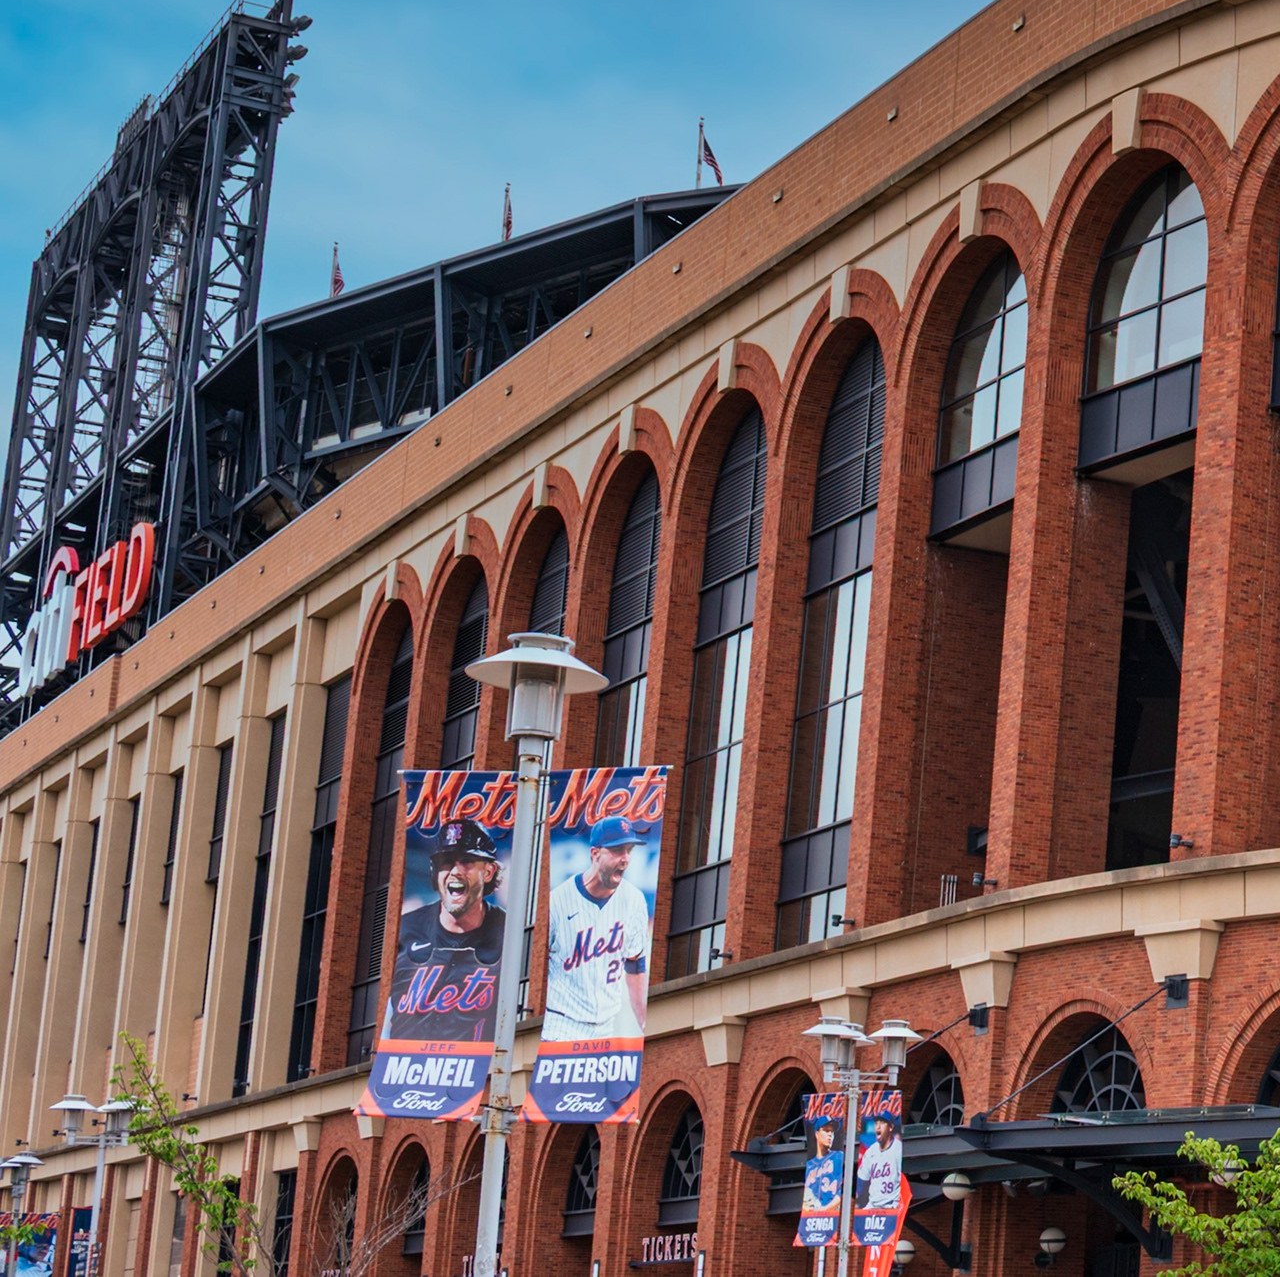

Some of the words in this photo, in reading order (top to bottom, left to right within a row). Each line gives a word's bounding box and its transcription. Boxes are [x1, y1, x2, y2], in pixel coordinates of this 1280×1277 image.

[66, 522, 154, 662] FIELD
[406, 771, 518, 829] Mets
[549, 766, 667, 829] Mets
[397, 964, 497, 1015] Mets
[420, 1042, 456, 1053] JEFF
[572, 1041, 612, 1052] DAVID
[382, 1057, 474, 1087] McNEIL
[535, 1055, 639, 1085] PETERSON
[392, 1090, 447, 1112] Ford
[555, 1091, 608, 1114] Ford
[805, 1093, 846, 1121] Mets
[860, 1090, 902, 1118] Mets
[820, 1176, 838, 1195] 34
[880, 1182, 895, 1195] 39
[805, 1217, 834, 1231] SENGA
[864, 1214, 887, 1230] DÍAZ
[641, 1232, 698, 1263] TICKETS
[806, 1233, 827, 1243] Ford
[863, 1231, 884, 1242] Ford
